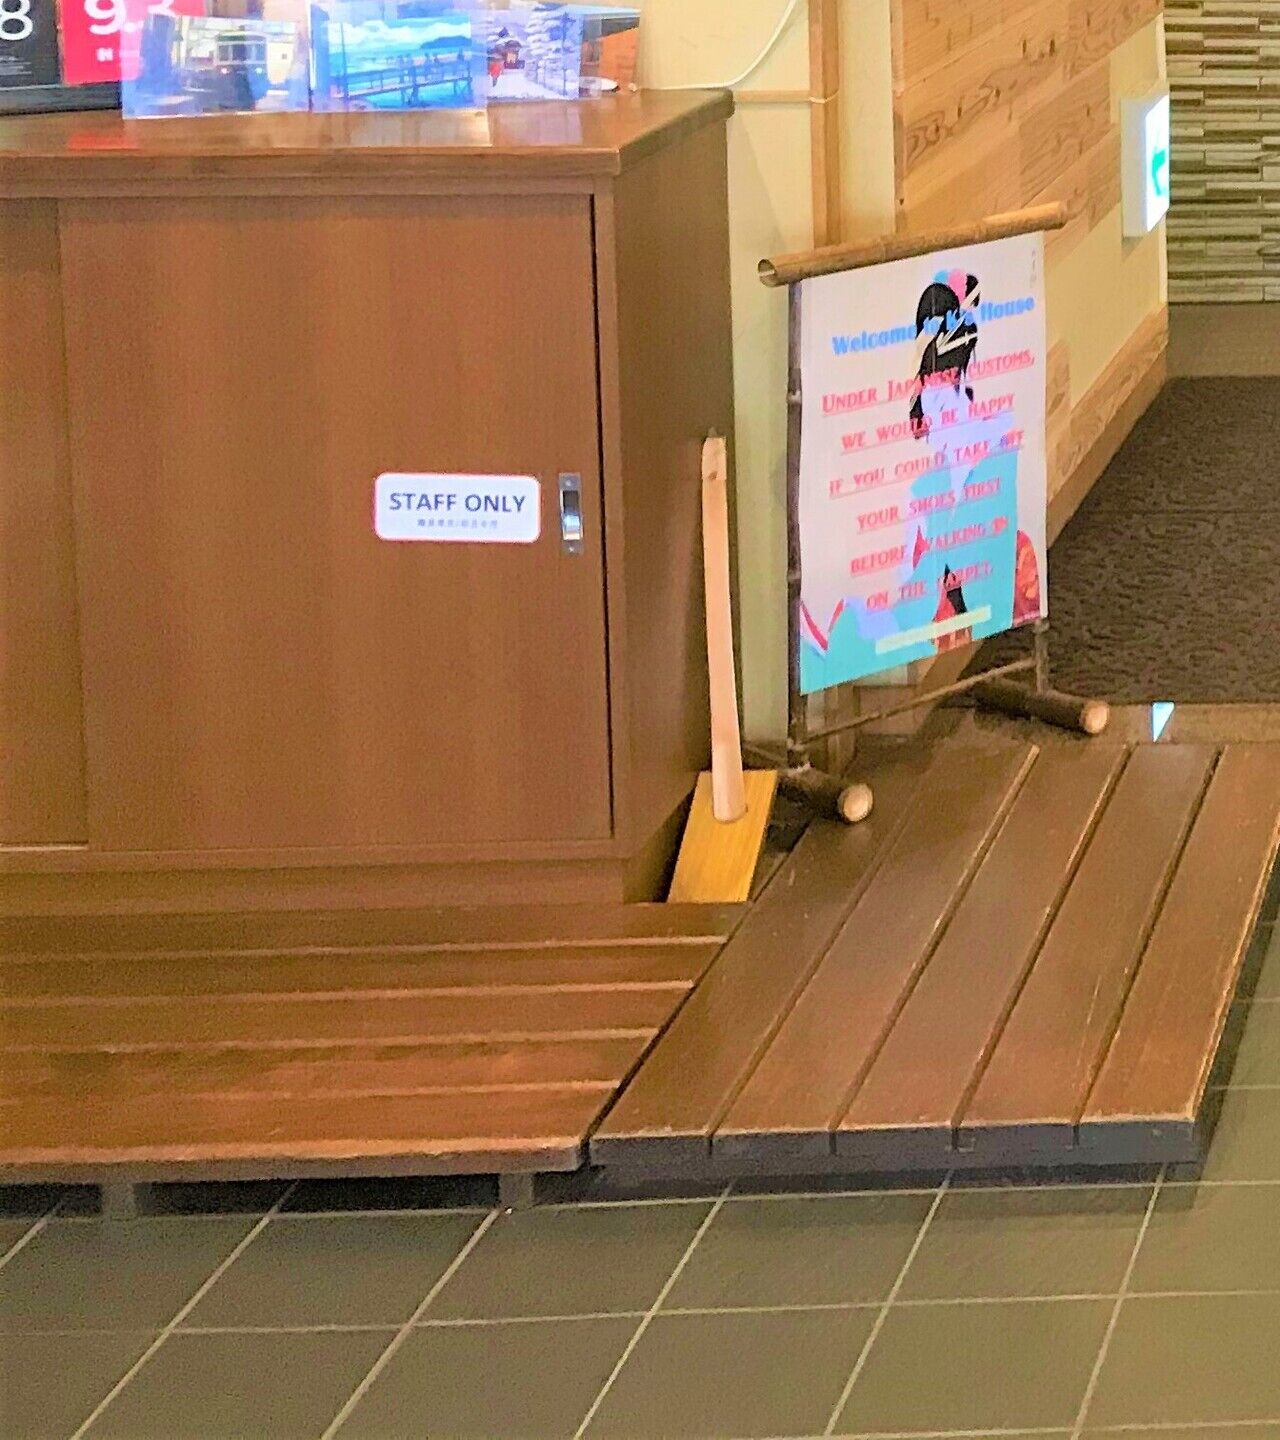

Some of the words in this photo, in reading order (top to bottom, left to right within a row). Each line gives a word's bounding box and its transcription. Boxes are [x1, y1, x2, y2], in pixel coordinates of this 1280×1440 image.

[831, 322, 917, 356] Welcome
[979, 297, 1036, 322] House
[821, 387, 877, 412] UNDER
[967, 350, 1035, 378] CUSTOMS,
[841, 431, 866, 450] WE
[876, 414, 932, 442] WOULD
[941, 408, 958, 424] BE
[968, 394, 1015, 416] HAPPY
[829, 478, 844, 495] IF
[853, 467, 885, 487] YOU
[895, 452, 945, 477] COULD
[953, 440, 990, 462] TAKE
[389, 492, 457, 512] STAFF
[464, 494, 526, 513] ONLY
[857, 506, 899, 530] YOUR
[909, 490, 956, 513] SHOES
[964, 477, 1001, 501] FIRST
[851, 545, 907, 574] BEFORE
[866, 591, 888, 610] ON
[899, 580, 926, 601] THE
